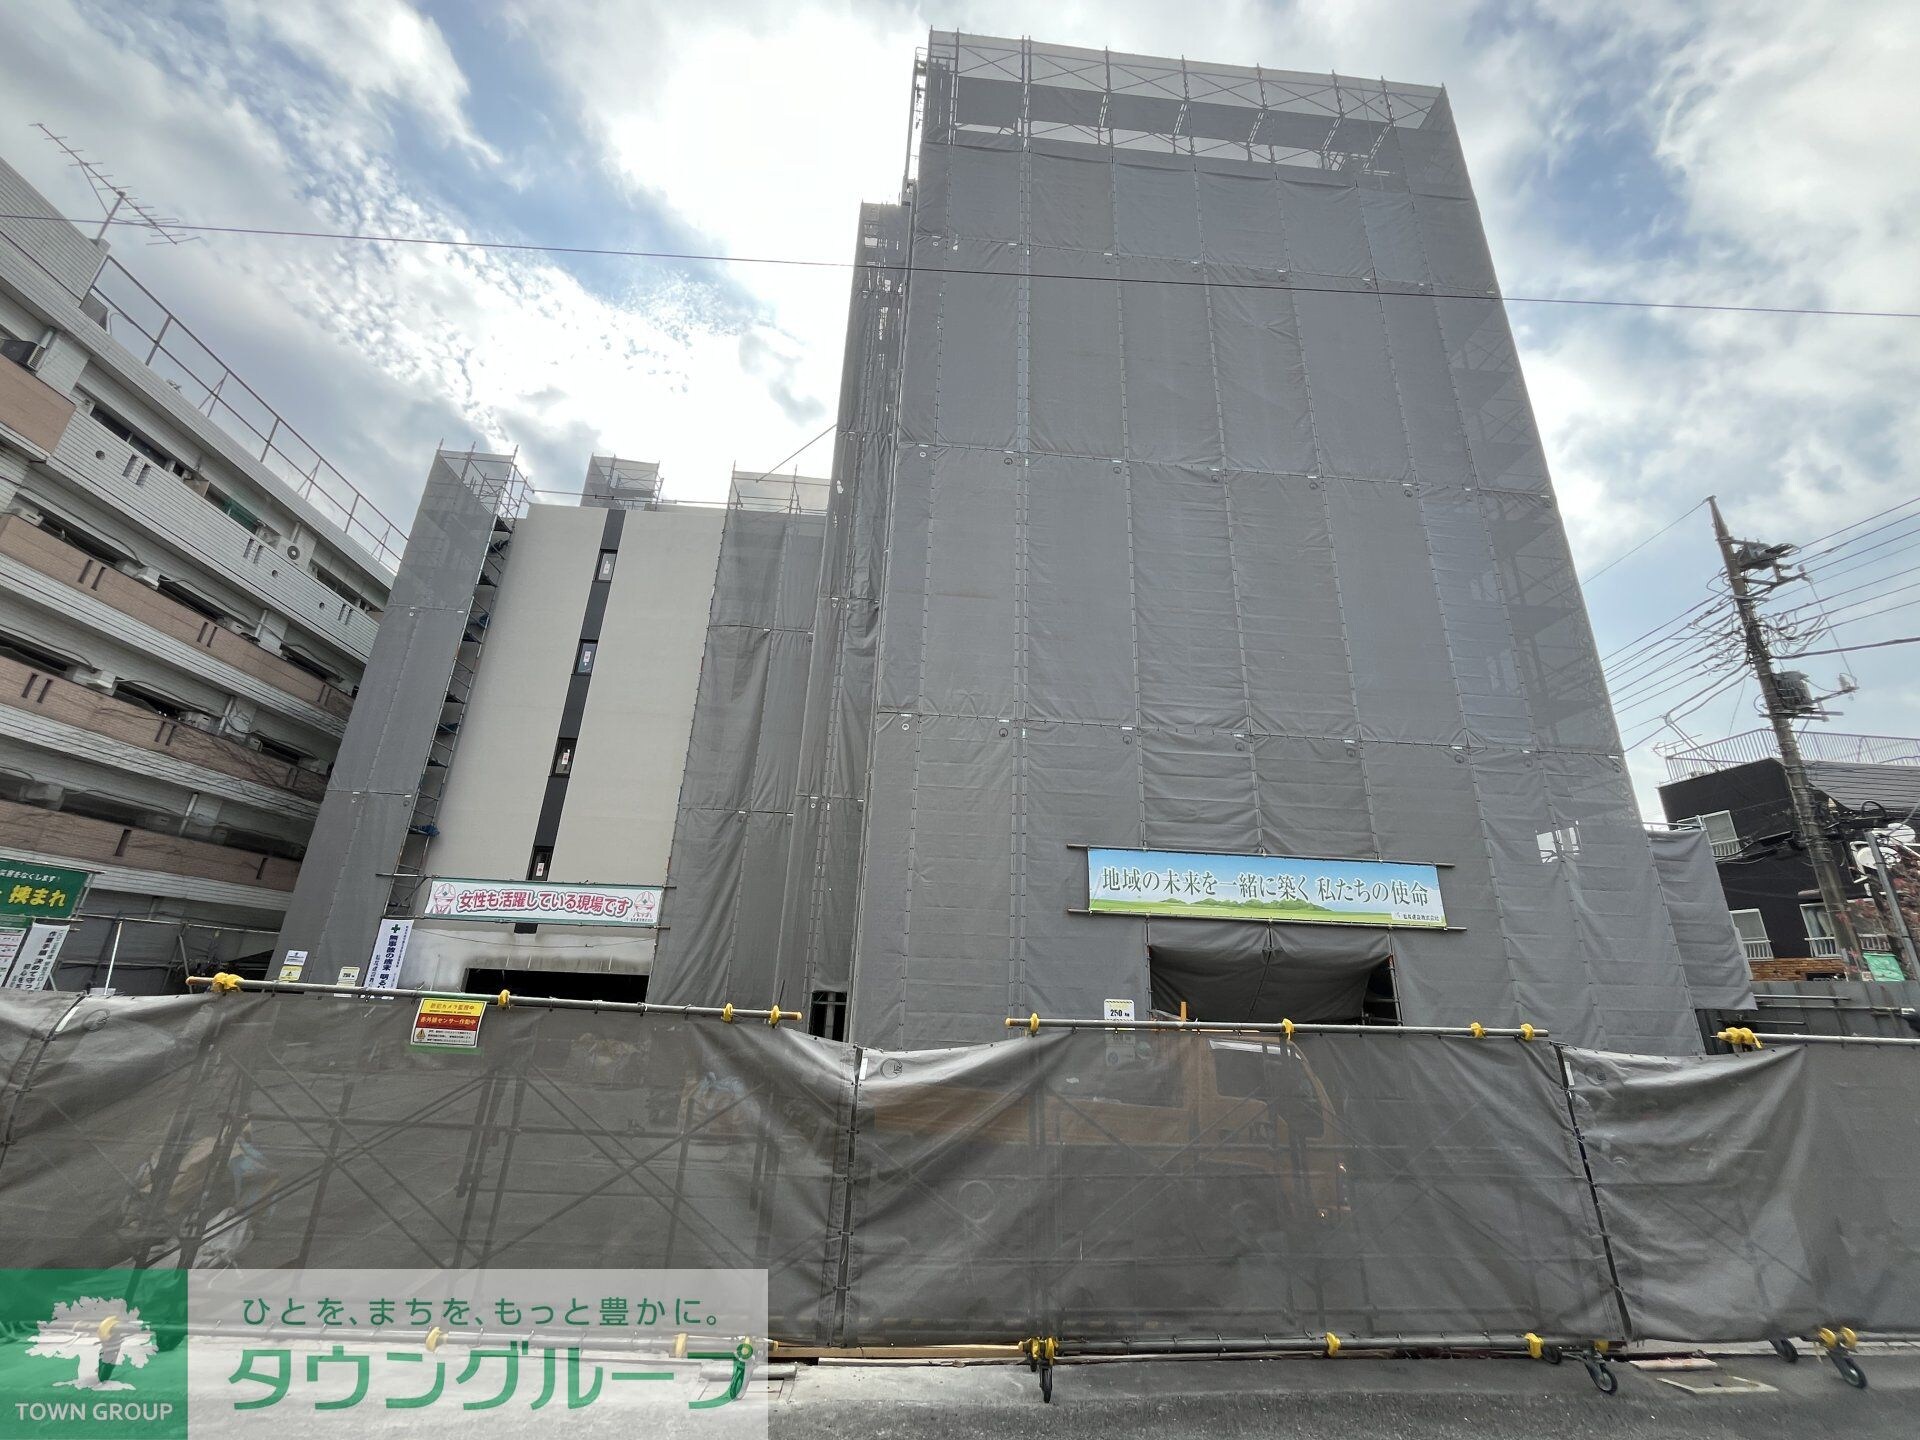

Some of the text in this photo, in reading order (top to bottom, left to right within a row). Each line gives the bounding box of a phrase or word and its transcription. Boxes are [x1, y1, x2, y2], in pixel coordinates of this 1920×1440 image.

[1102, 867, 1429, 906] 地域の未来を一緒に築く 私たちの使命
[459, 891, 631, 916] 女性も活躍している現場です
[1110, 1009, 1123, 1017] 250
